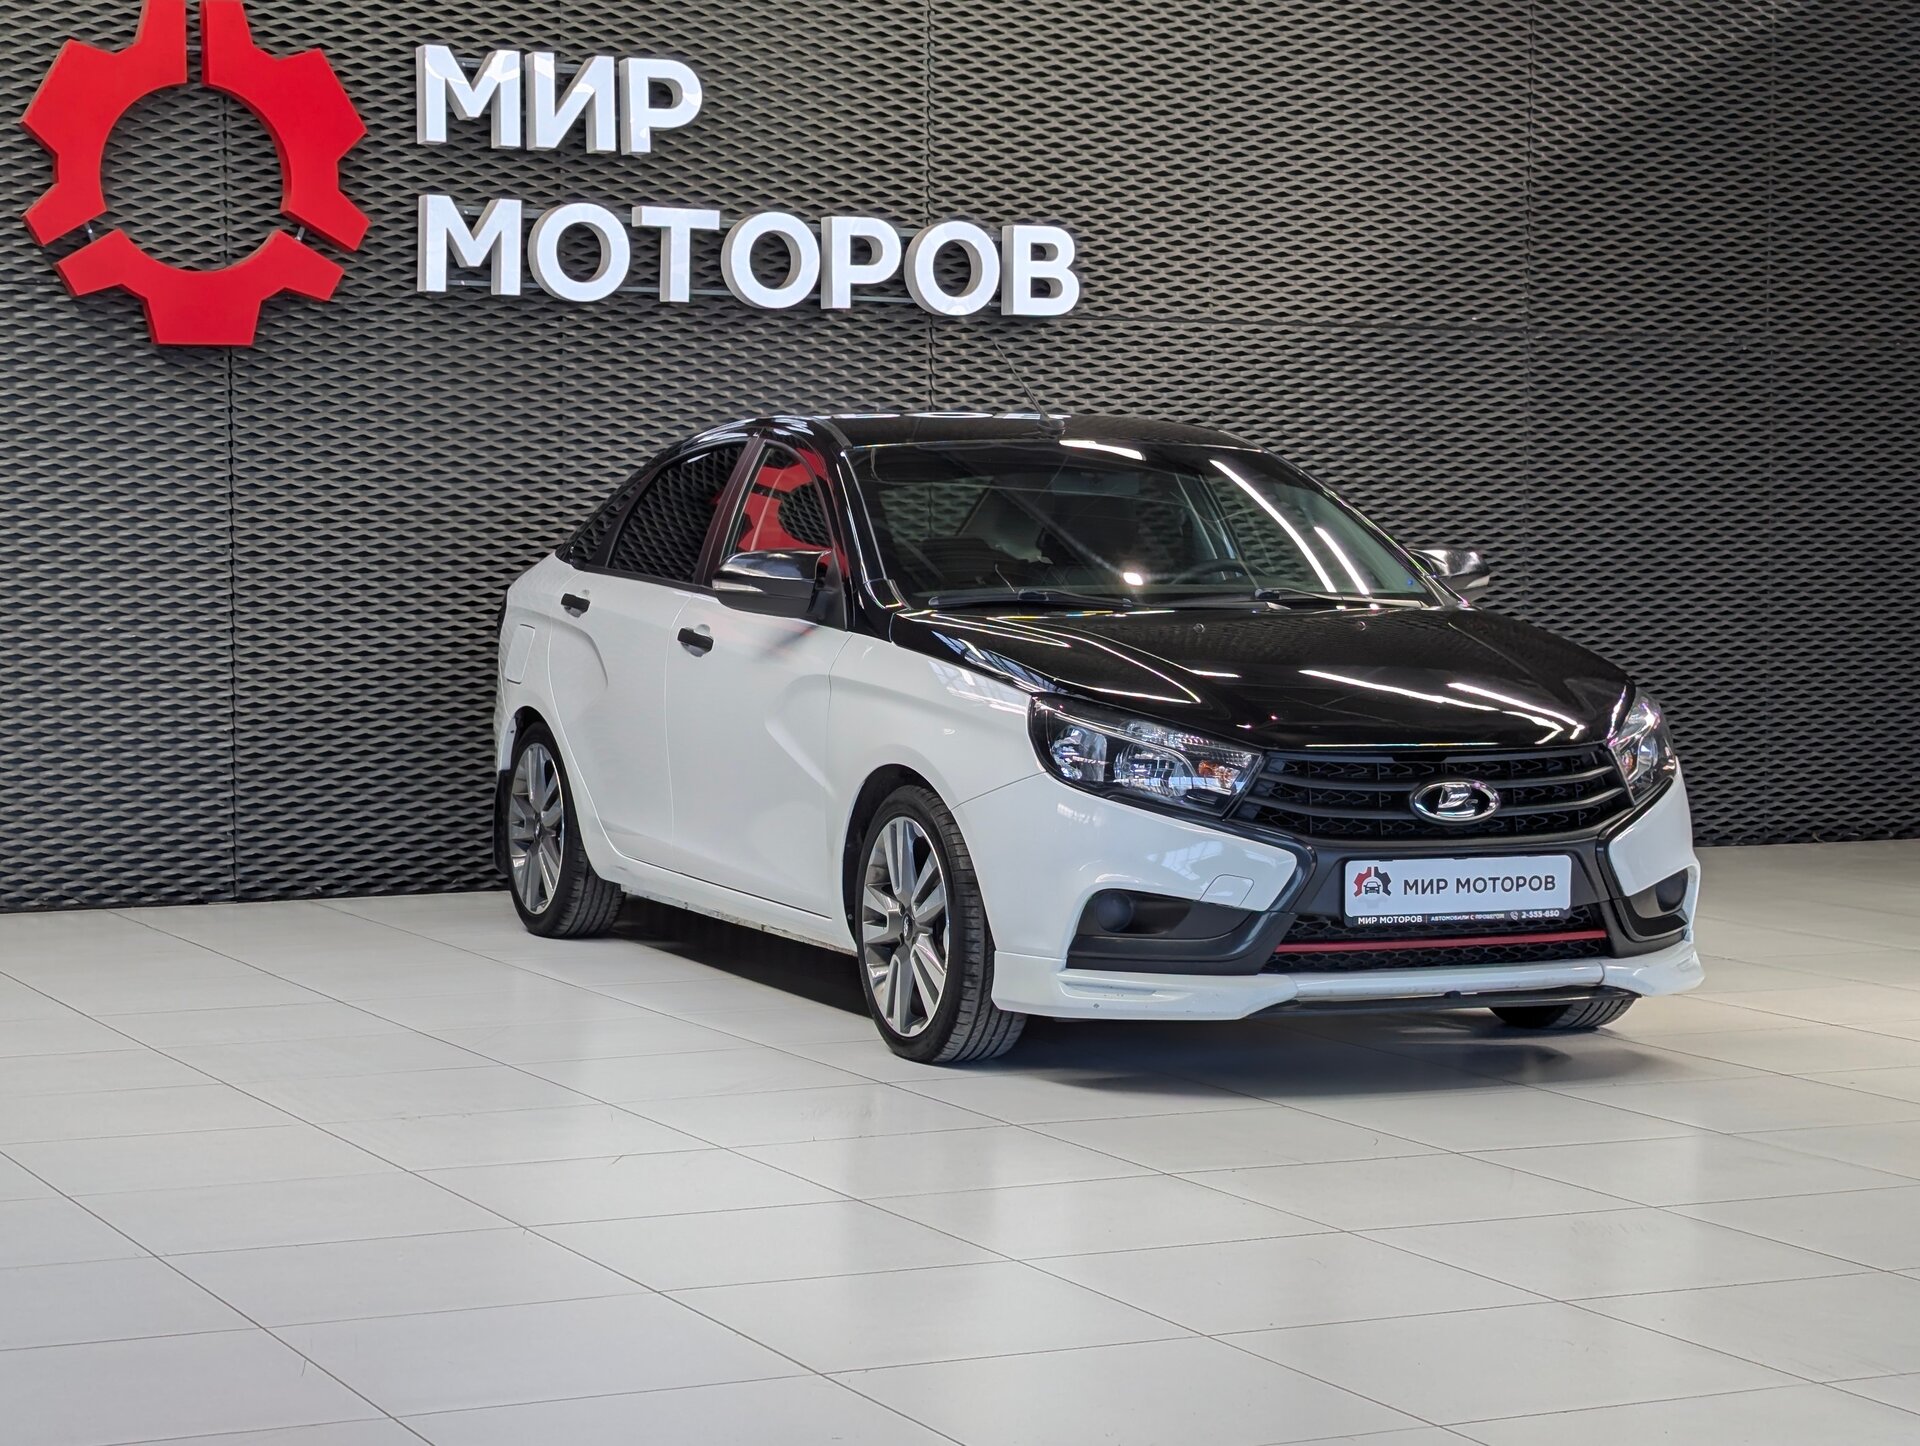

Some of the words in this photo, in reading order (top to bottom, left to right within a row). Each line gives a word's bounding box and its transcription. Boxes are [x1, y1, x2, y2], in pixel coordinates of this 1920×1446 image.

[416, 44, 703, 155] МИР
[416, 194, 1081, 316] МОТОРОВ
[1403, 878, 1449, 895] МИР
[1455, 875, 1556, 894] МОТОРОВ
[1358, 917, 1378, 925] МИР
[1380, 915, 1423, 924] МОТОРОВ
[1430, 914, 1469, 922] АВТОМОБИЛИ
